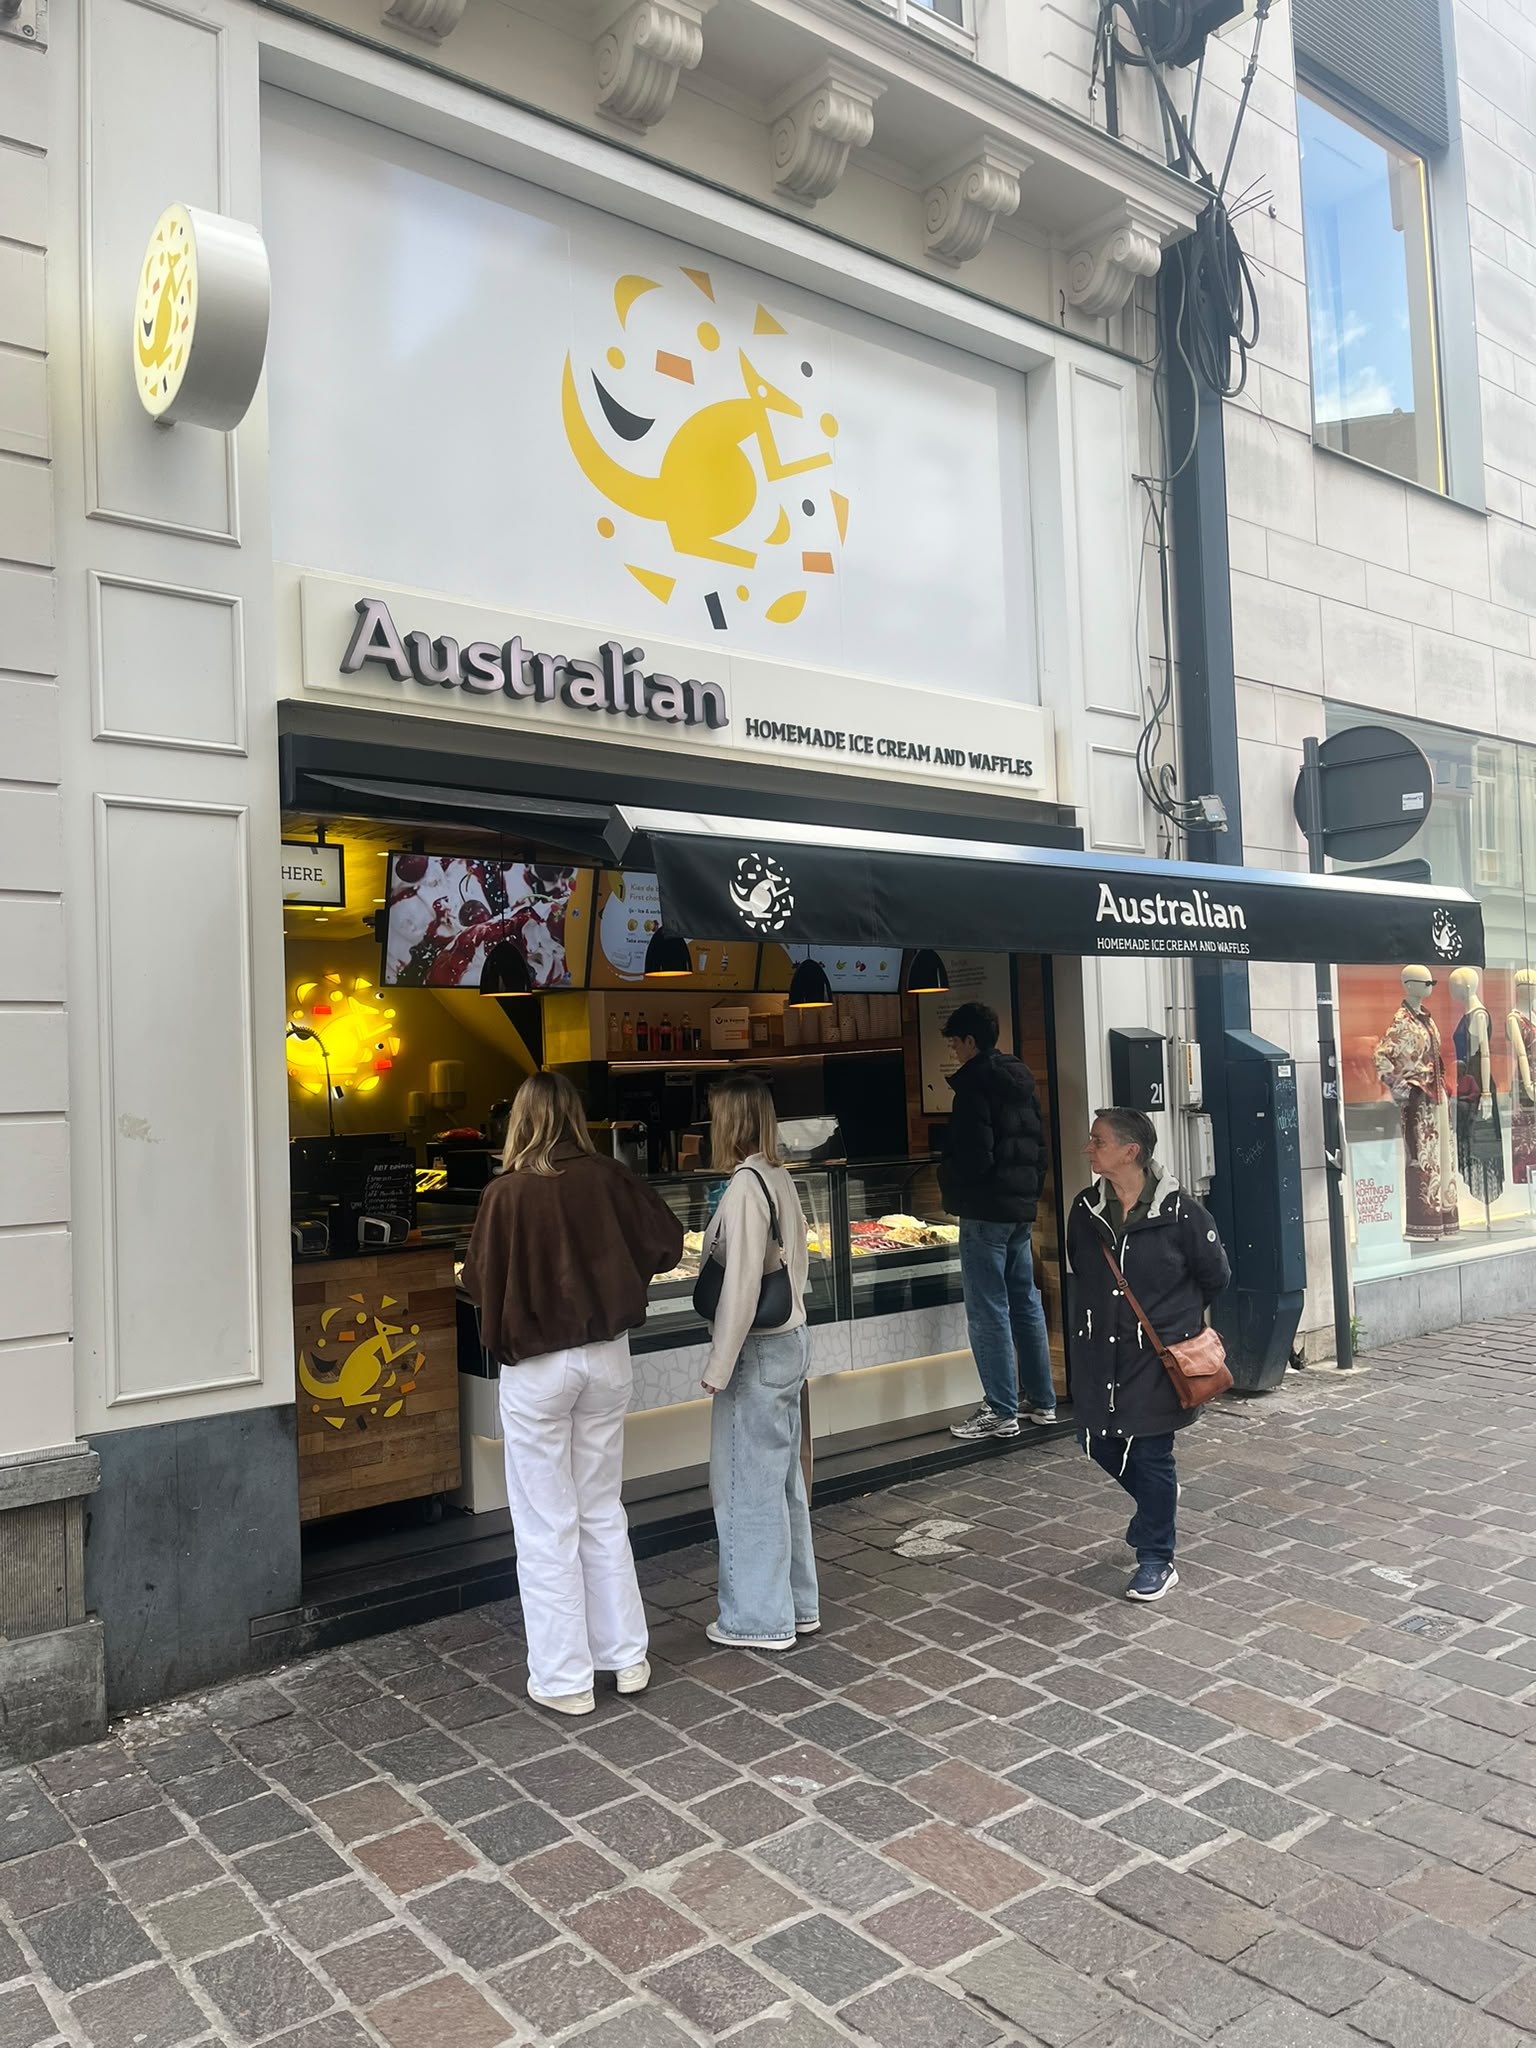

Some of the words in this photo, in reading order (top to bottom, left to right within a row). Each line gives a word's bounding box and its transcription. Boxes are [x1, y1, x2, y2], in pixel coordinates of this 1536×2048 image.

[341, 598, 729, 729] Australian
[745, 717, 846, 749] HOMEMADE
[849, 733, 874, 754] ICE
[877, 738, 931, 763] CREAM
[933, 747, 965, 767] AND
[968, 751, 1033, 776] WAFFLES
[281, 866, 323, 882] HERE
[1096, 883, 1247, 930] Australian
[1097, 937, 1150, 951] HOMEMADE
[1151, 939, 1165, 951] ICE
[1166, 939, 1199, 952] CREAM
[1199, 940, 1217, 952] AND
[1217, 941, 1250, 955] WAFFLES
[1150, 1082, 1163, 1104] 21
[1356, 1186, 1384, 1197] KORTING
[1357, 1194, 1389, 1205] AANKOOP
[1358, 1212, 1393, 1224] ARTIKELEN
